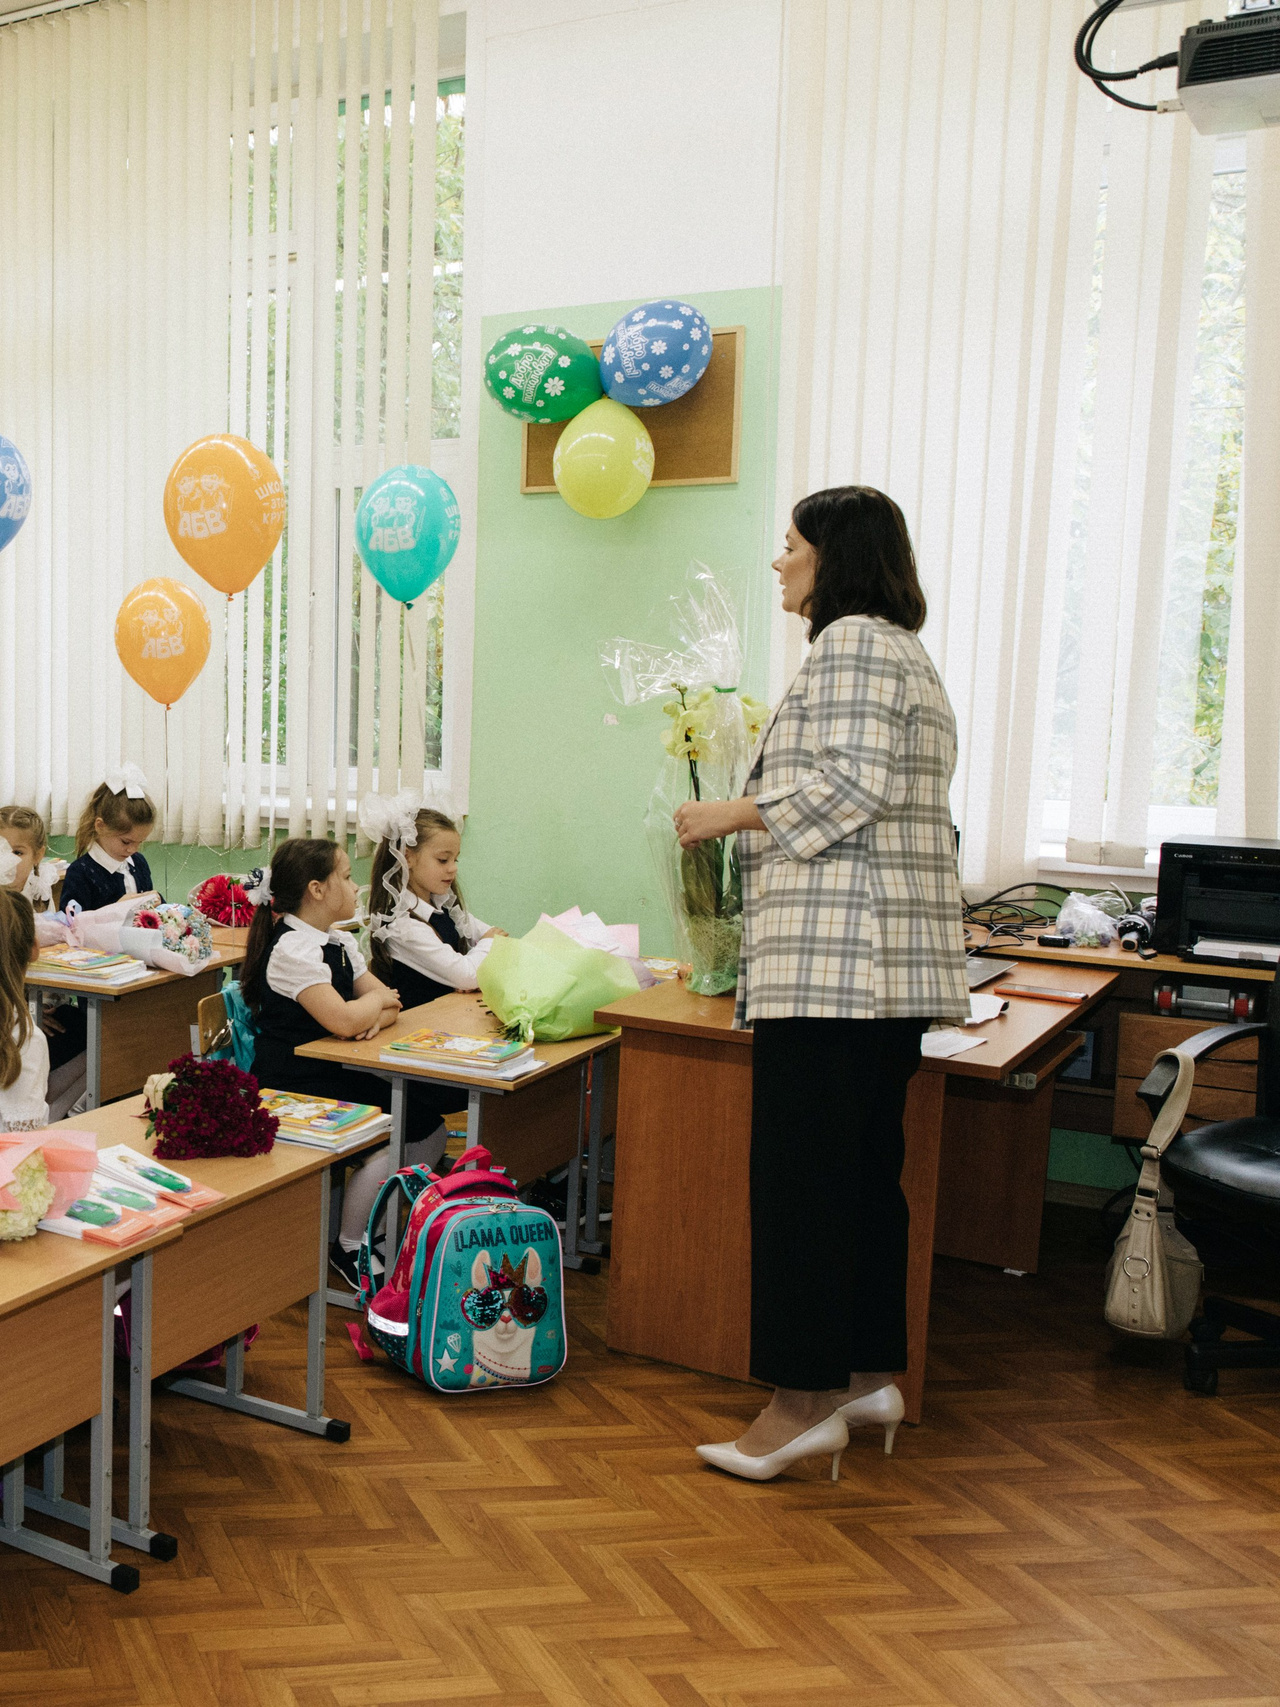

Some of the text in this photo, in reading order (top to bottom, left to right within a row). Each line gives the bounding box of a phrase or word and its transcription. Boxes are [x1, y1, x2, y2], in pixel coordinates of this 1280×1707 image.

[626, 324, 648, 359] Добро
[510, 352, 536, 389] Добро
[178, 509, 227, 539] АБВ
[369, 528, 417, 553] АБВ
[141, 635, 186, 659] АБВ
[453, 1220, 554, 1252] LLAMA QUEEN
